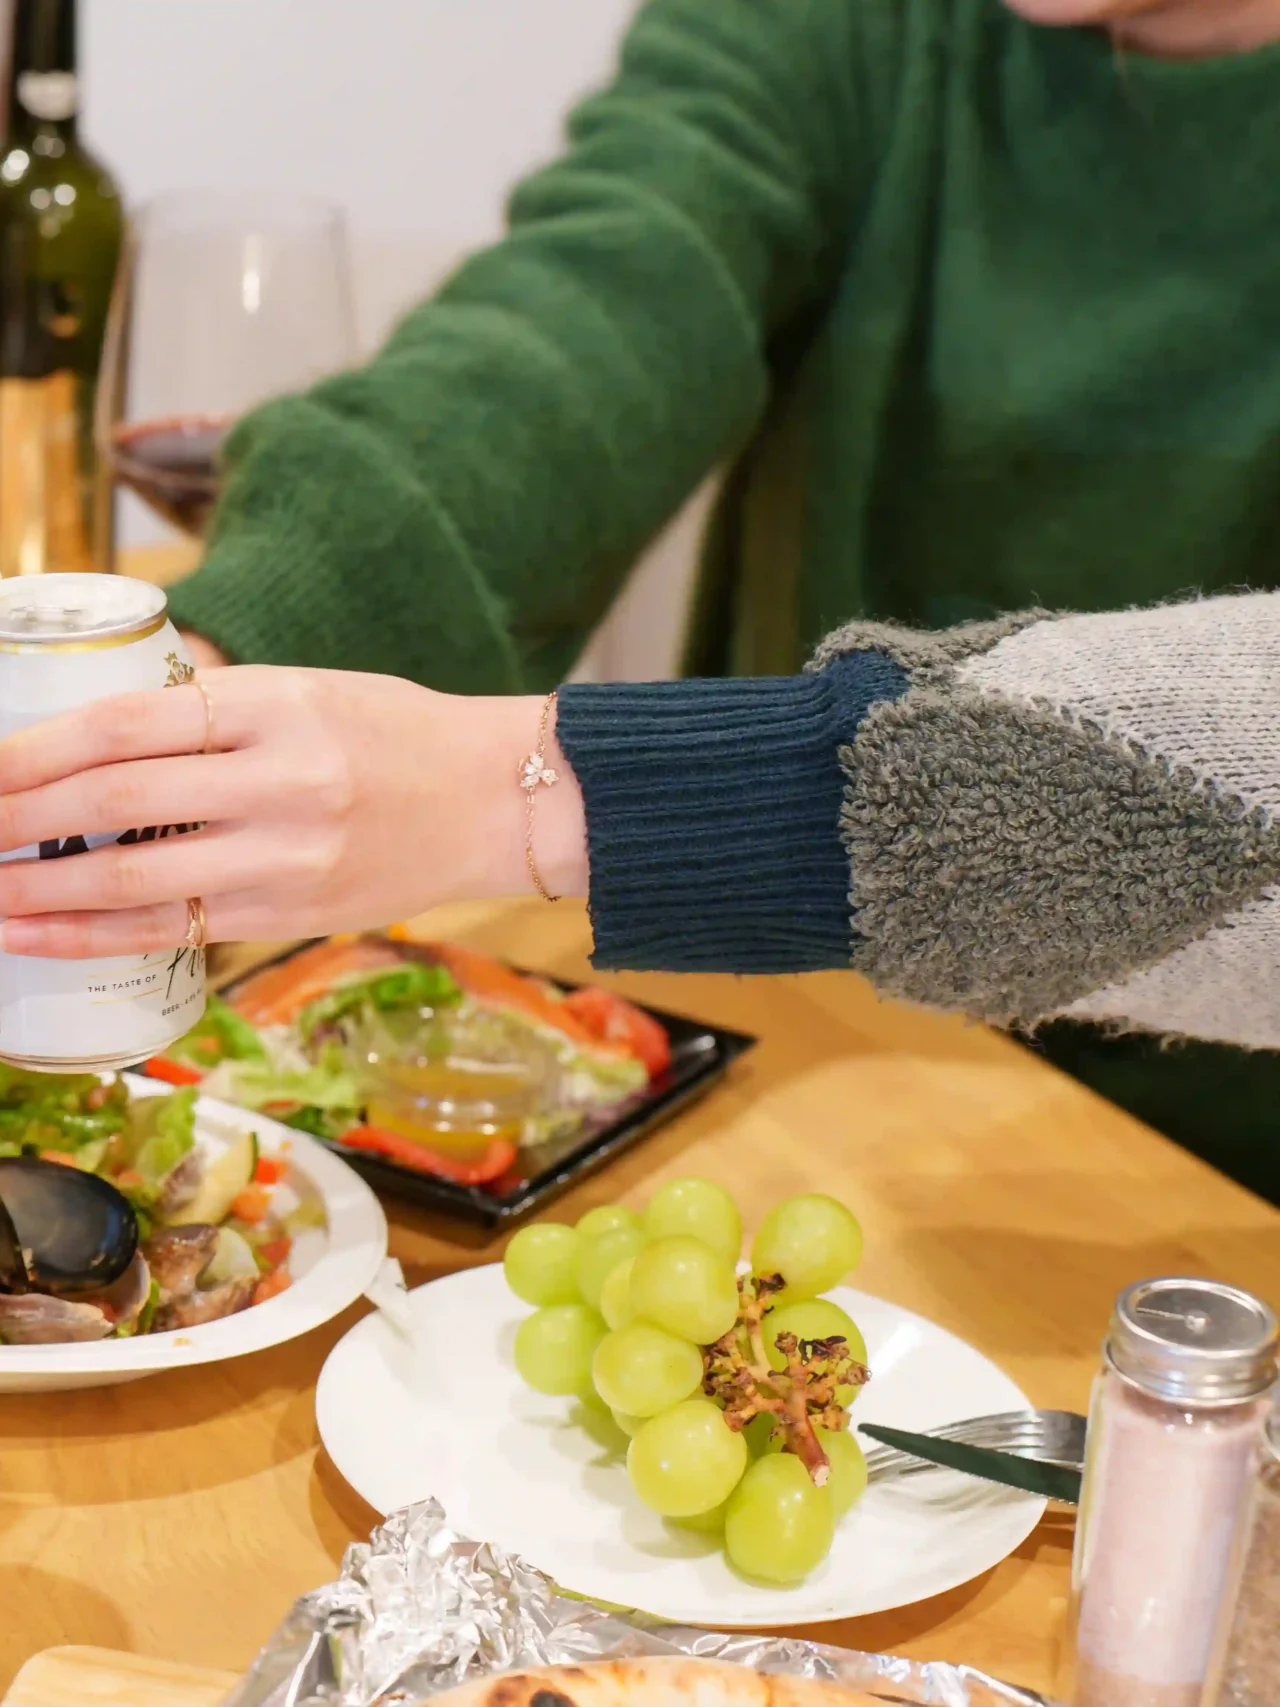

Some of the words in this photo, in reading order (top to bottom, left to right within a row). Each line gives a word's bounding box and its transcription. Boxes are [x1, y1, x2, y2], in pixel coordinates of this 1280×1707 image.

[88, 984, 107, 993] THE
[112, 977, 141, 990] TASTE
[145, 974, 157, 984] OF
